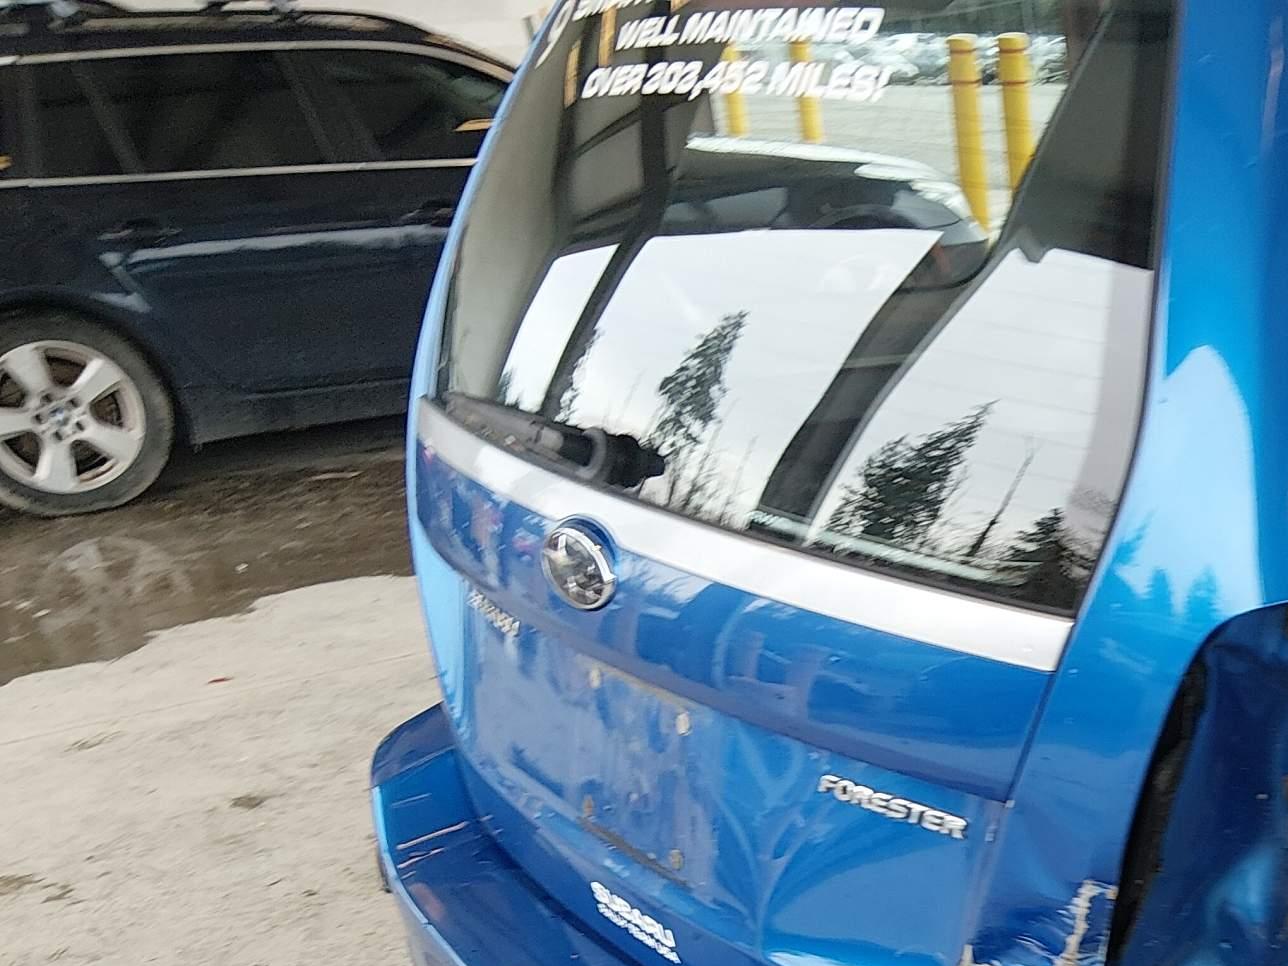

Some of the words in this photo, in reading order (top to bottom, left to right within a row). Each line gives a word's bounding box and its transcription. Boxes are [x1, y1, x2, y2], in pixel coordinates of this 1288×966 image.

[615, 14, 682, 51] WELL
[679, 7, 886, 45] MAINTAINED
[581, 63, 650, 99] OVER
[766, 60, 890, 102] MILES!
[816, 774, 969, 840] FORESTER
